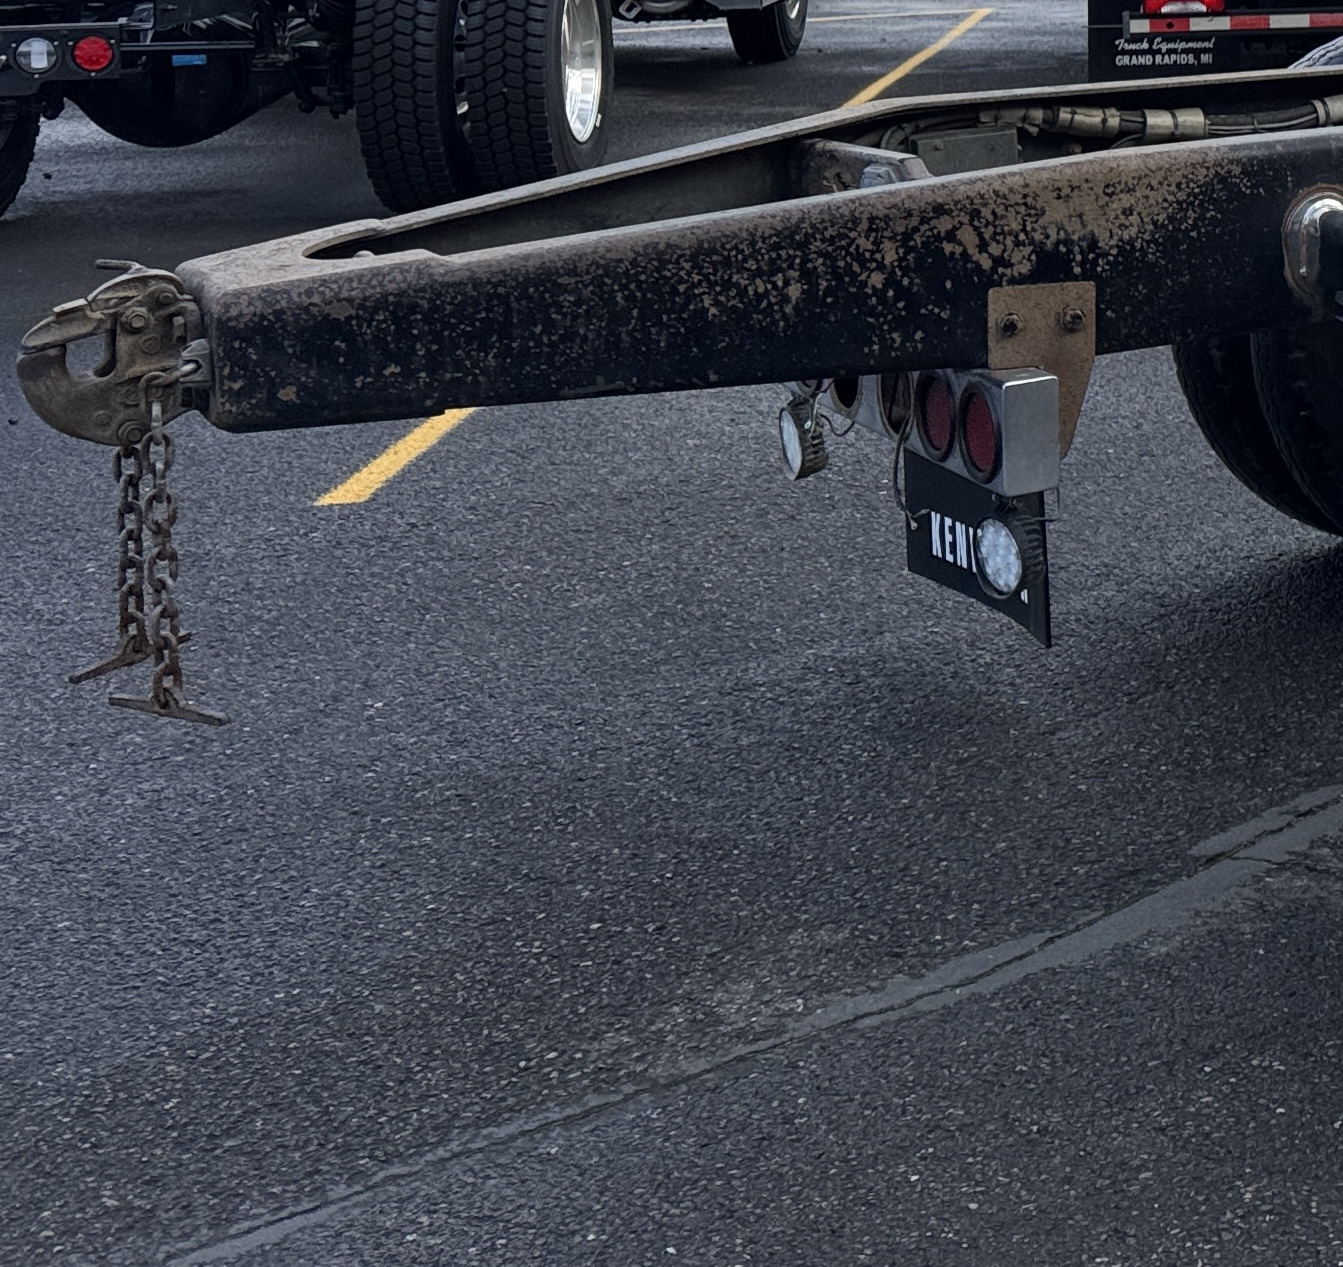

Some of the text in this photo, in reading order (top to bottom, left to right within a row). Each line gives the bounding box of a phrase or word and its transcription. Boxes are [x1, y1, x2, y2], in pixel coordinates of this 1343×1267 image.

[1114, 36, 1216, 53] Truck Equipment
[1115, 53, 1213, 66] GRAND RAPIDS, MI
